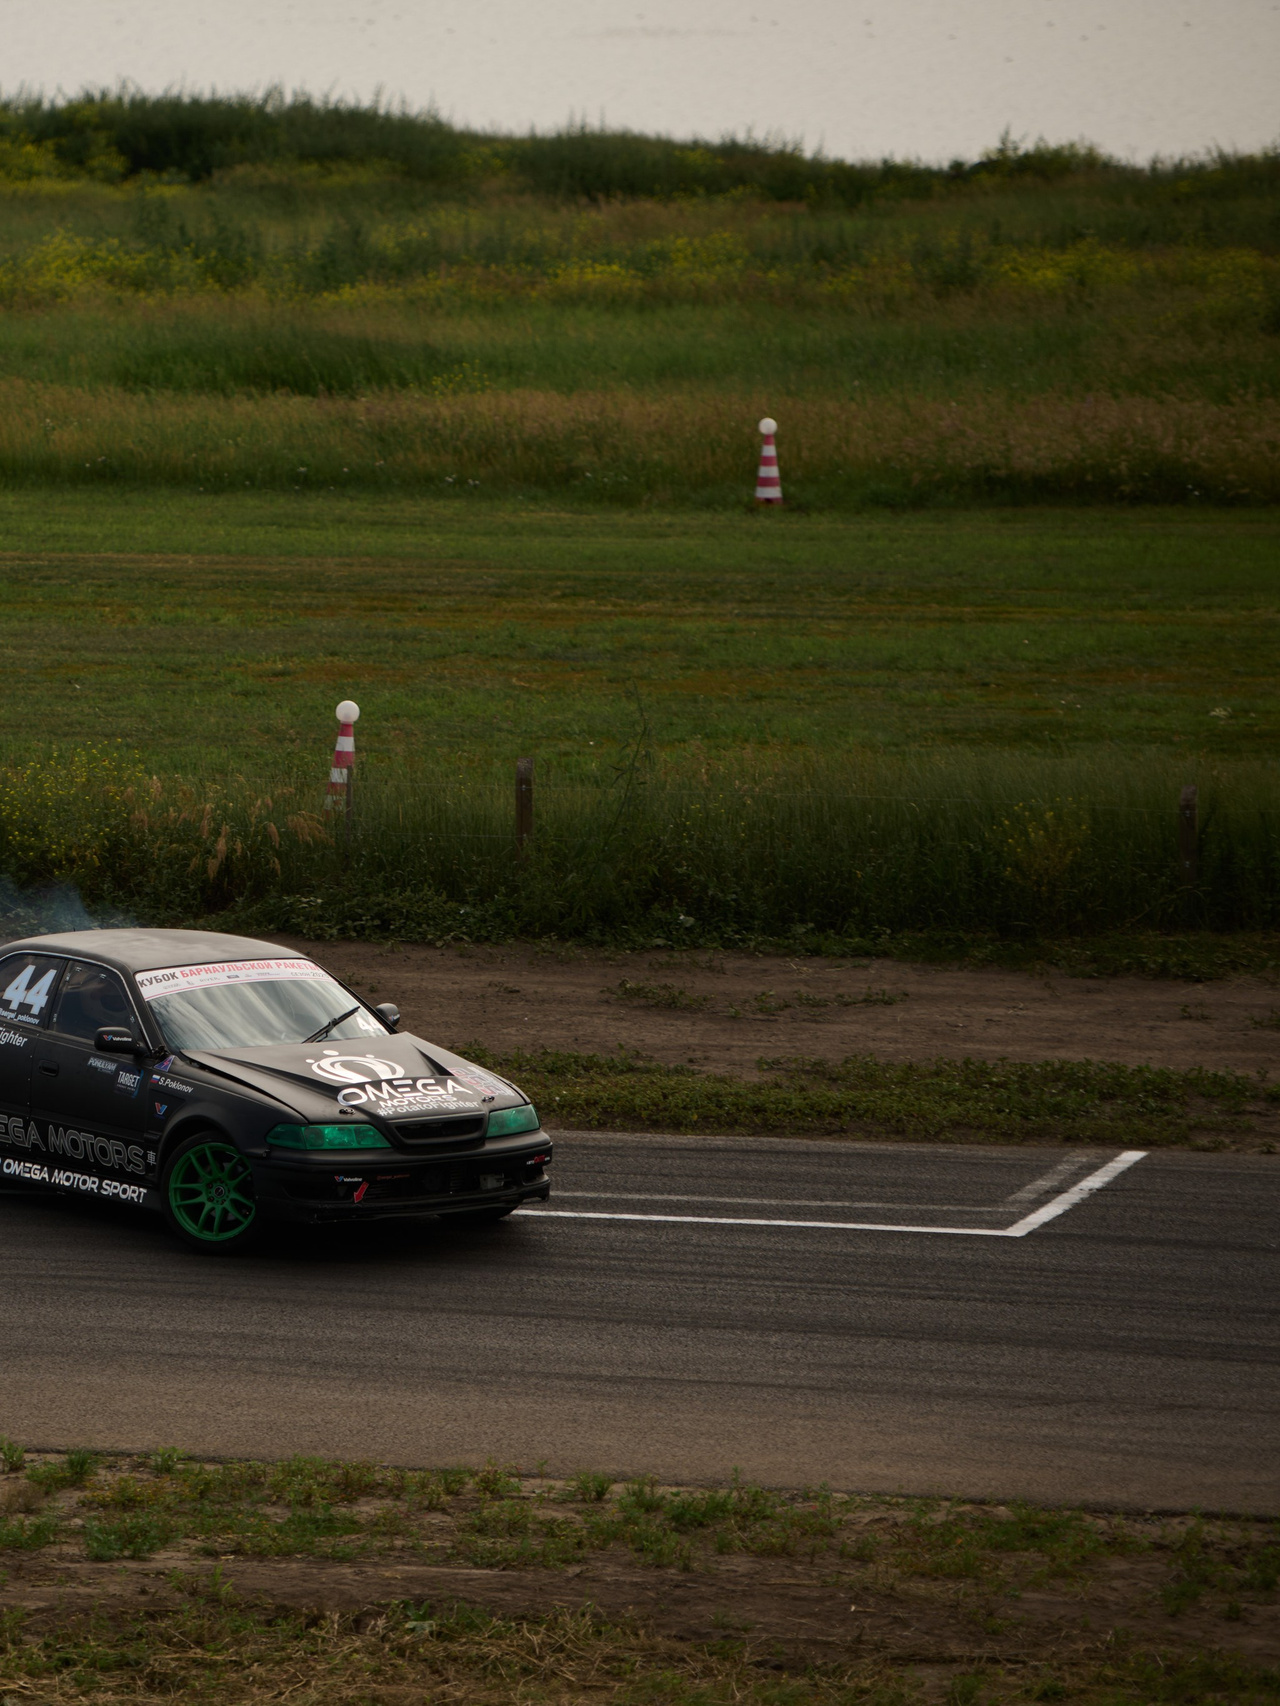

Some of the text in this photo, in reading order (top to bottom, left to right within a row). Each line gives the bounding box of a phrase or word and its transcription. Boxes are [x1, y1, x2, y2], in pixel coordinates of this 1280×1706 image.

[137, 971, 179, 989] КУБОК
[180, 960, 272, 978] БАРНАУЛЬСКОЙ
[1, 965, 57, 1015] 44
[117, 1071, 140, 1088] TARGET
[158, 1077, 194, 1094] S.Poklonov
[337, 1078, 473, 1107] OMEGA
[376, 1100, 480, 1117] #PotatoFighter
[378, 1094, 457, 1109] MOTORS
[47, 1124, 146, 1175] MOTORS
[2, 1158, 50, 1183] OMEGA
[51, 1169, 99, 1193] MOTOR
[99, 1179, 148, 1203] SPORT
